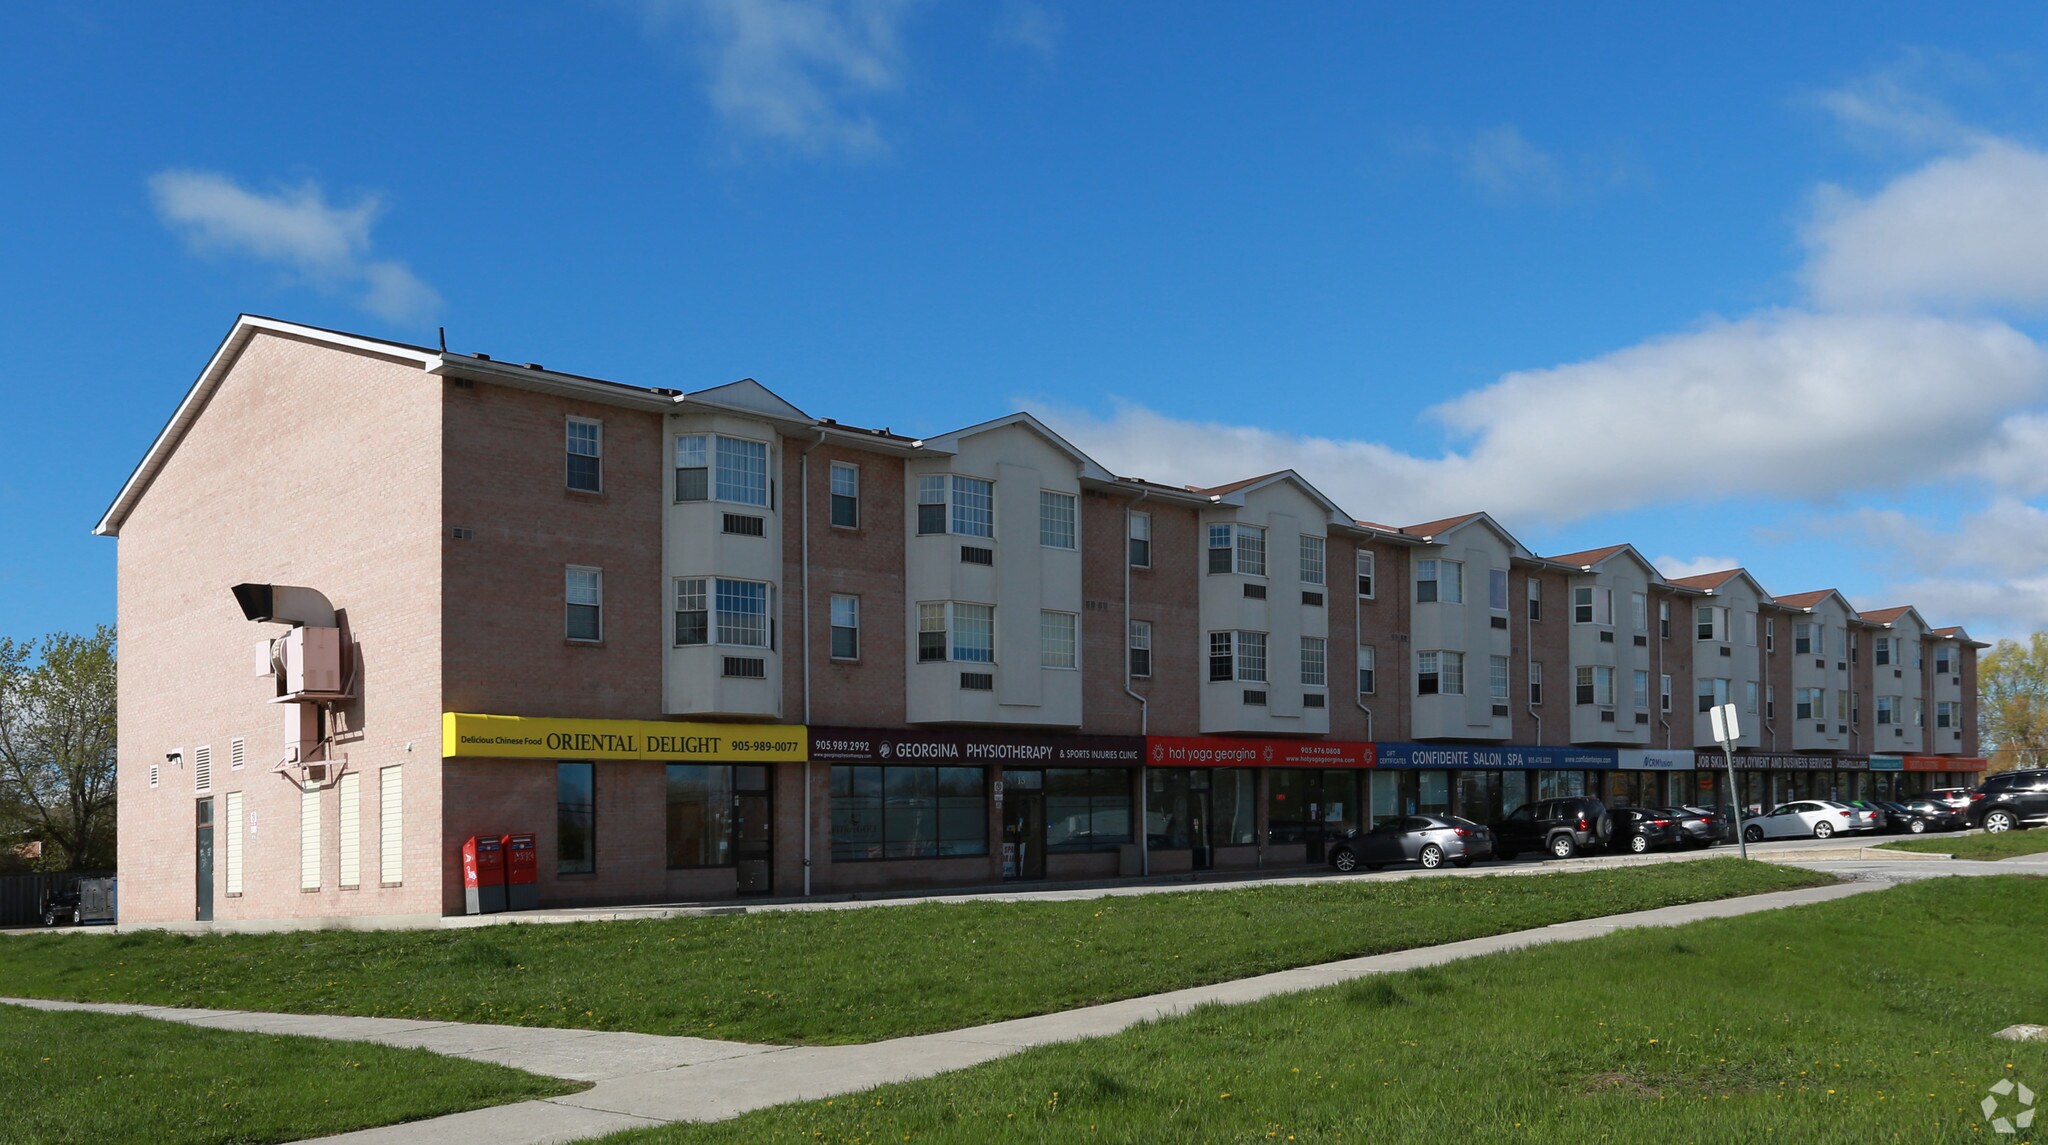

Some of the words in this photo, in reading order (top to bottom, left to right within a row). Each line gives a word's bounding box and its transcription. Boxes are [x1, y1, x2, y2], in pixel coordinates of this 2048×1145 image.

[461, 736, 494, 745] Delicious
[495, 736, 524, 745] Chinese
[524, 737, 543, 746] Food
[546, 733, 638, 752] ORIENTAL
[646, 736, 721, 754] DELIGHT
[731, 740, 798, 752] 905-989-0077
[815, 740, 870, 751] 905.989.2992
[896, 743, 959, 758] GEORGINA
[966, 744, 1053, 759] PHYSIOTHERAPY
[1059, 750, 1065, 758] &
[1066, 749, 1090, 759] SPORTS
[1091, 750, 1117, 759] INJURIES
[1118, 750, 1138, 759] CLINIC
[1169, 747, 1186, 759] hot
[1187, 749, 1212, 762] yoga
[1215, 749, 1256, 762] georgina
[1300, 747, 1341, 755] 905.476.0808
[1285, 754, 1355, 763] www.hotyogageorgina.com
[1411, 751, 1469, 765] CONFIDENTE
[1473, 752, 1502, 766] SALON
[1507, 753, 1524, 766] SPA
[1697, 755, 1710, 768] JOB
[1710, 755, 1729, 768] SKILL
[1733, 755, 1772, 768] EMPLOYMENT
[1772, 757, 1783, 769] AND
[1783, 757, 1809, 769] BUSINESS
[1809, 757, 1833, 769] SERVICES
